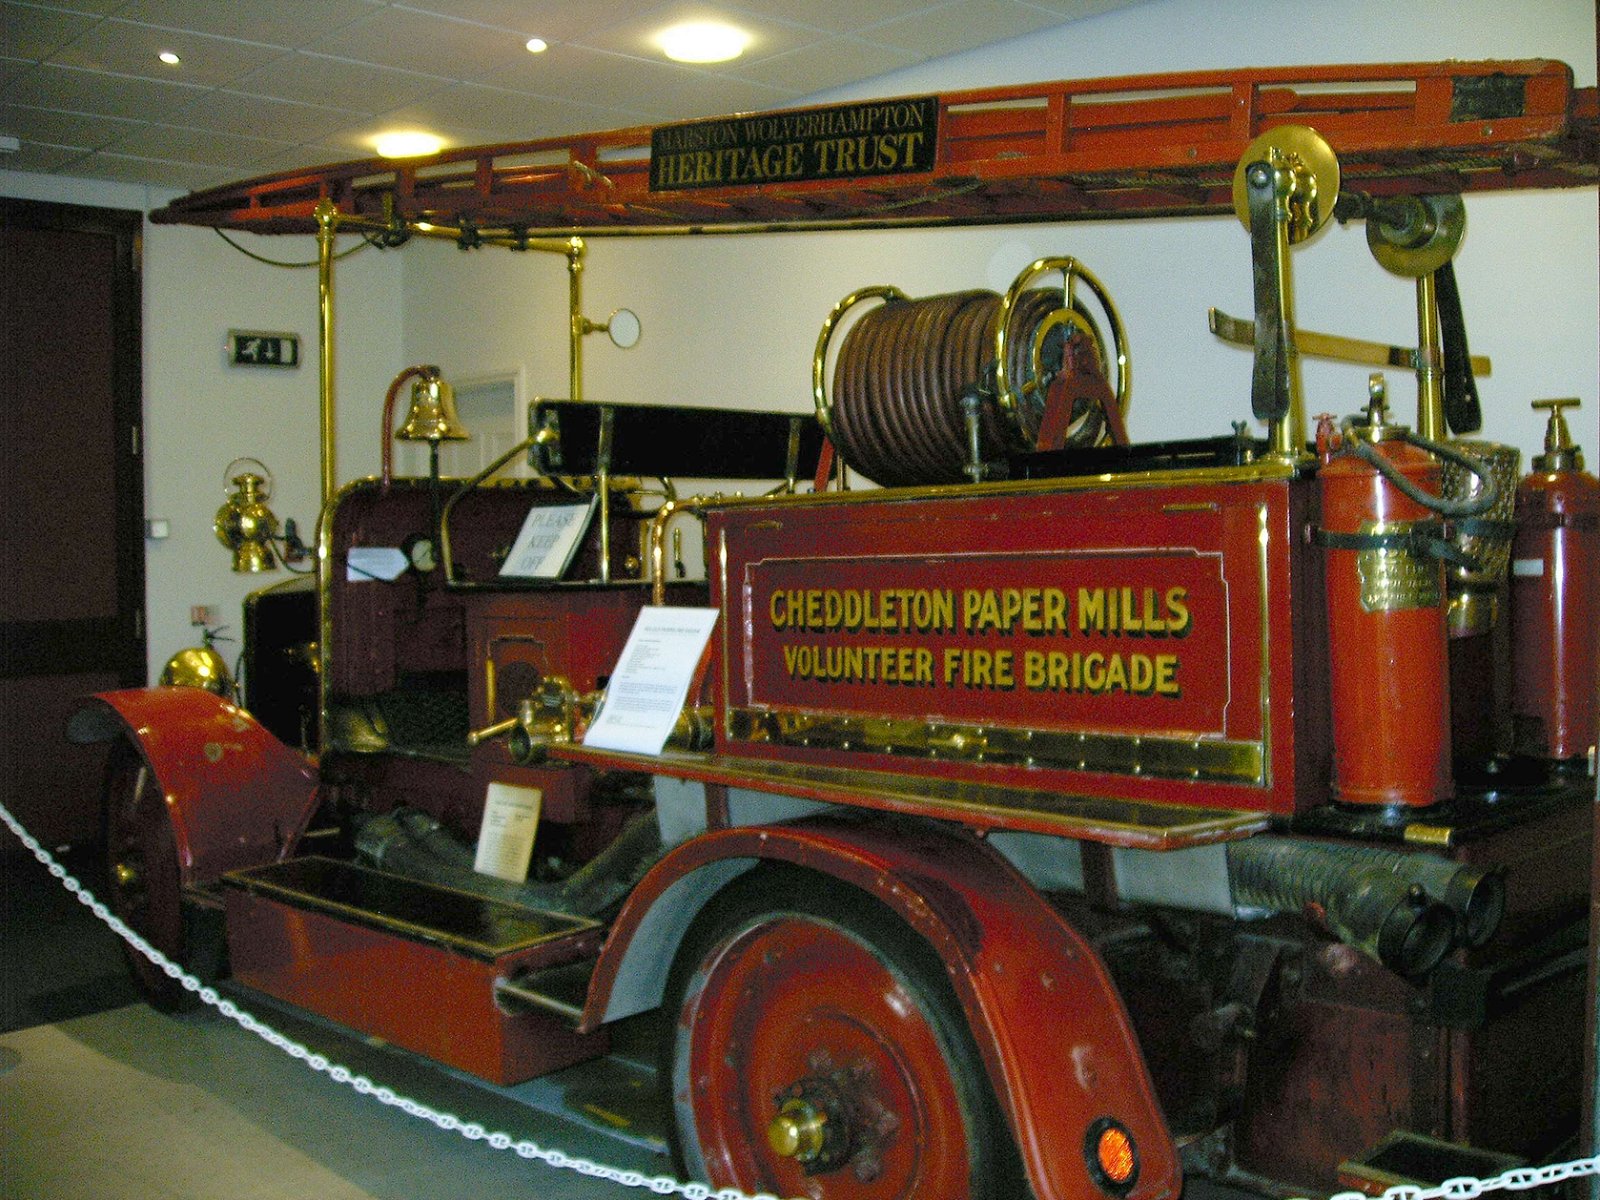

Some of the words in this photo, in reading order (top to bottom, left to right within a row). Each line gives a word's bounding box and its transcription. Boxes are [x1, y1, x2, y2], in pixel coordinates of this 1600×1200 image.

[744, 102, 925, 141] WOLVERHAMPTON
[657, 143, 804, 187] HERITAGE
[814, 132, 924, 174] TRUST
[769, 588, 953, 630] CHEDDLETON
[963, 588, 1067, 632] PAPER
[1078, 586, 1191, 633] MILLS
[783, 645, 934, 683] VOLUNTEER
[944, 648, 1014, 686] FIRE
[1024, 651, 1180, 694] BRIGADE
